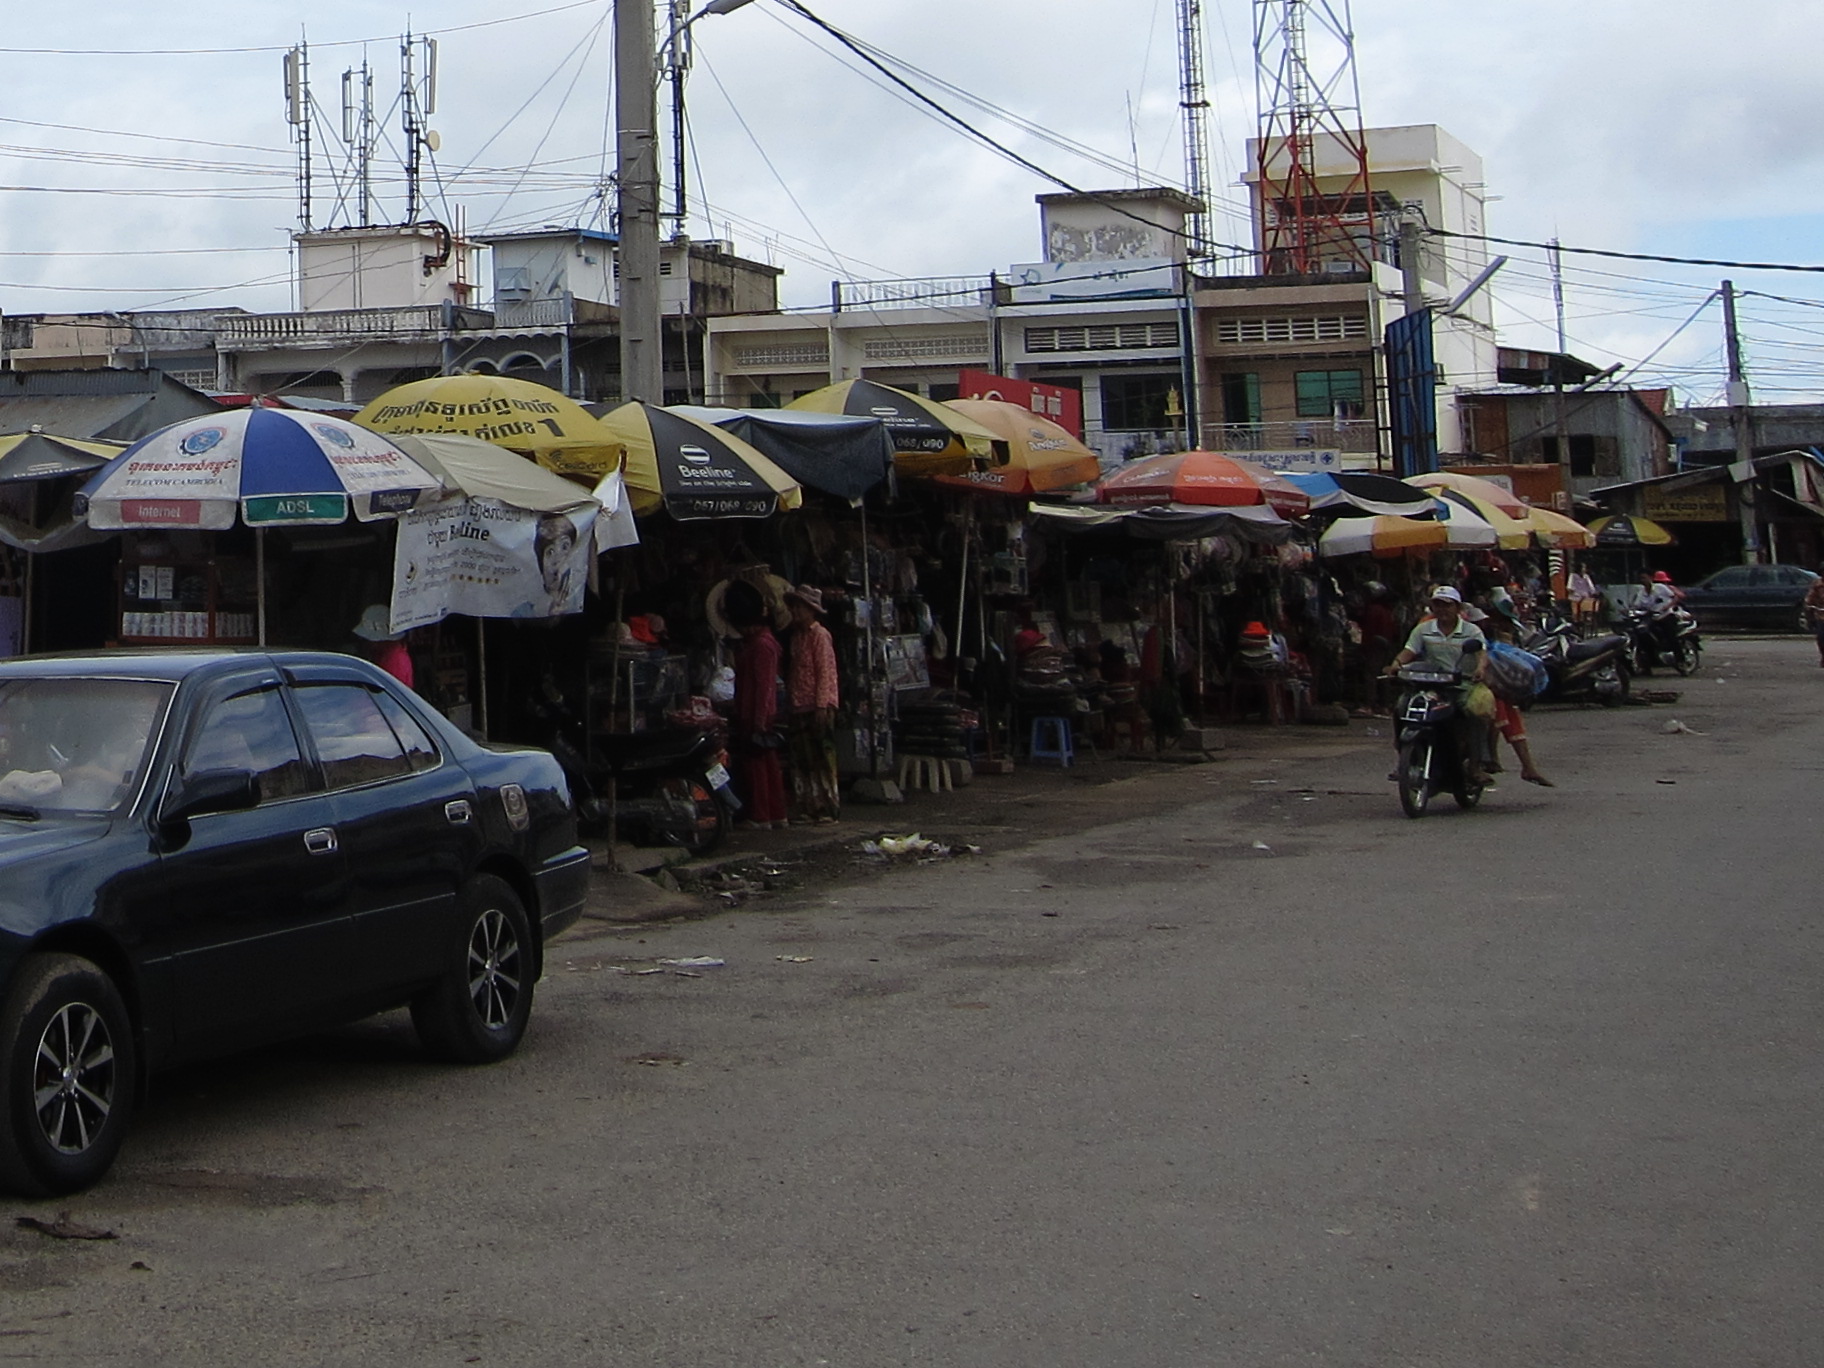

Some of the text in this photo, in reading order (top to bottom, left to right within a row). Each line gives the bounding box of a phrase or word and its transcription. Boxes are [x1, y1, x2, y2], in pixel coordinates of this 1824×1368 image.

[537, 418, 566, 438] 1
[677, 465, 734, 479] Beeline
[139, 505, 180, 518] Internet
[276, 500, 315, 514] ADSL
